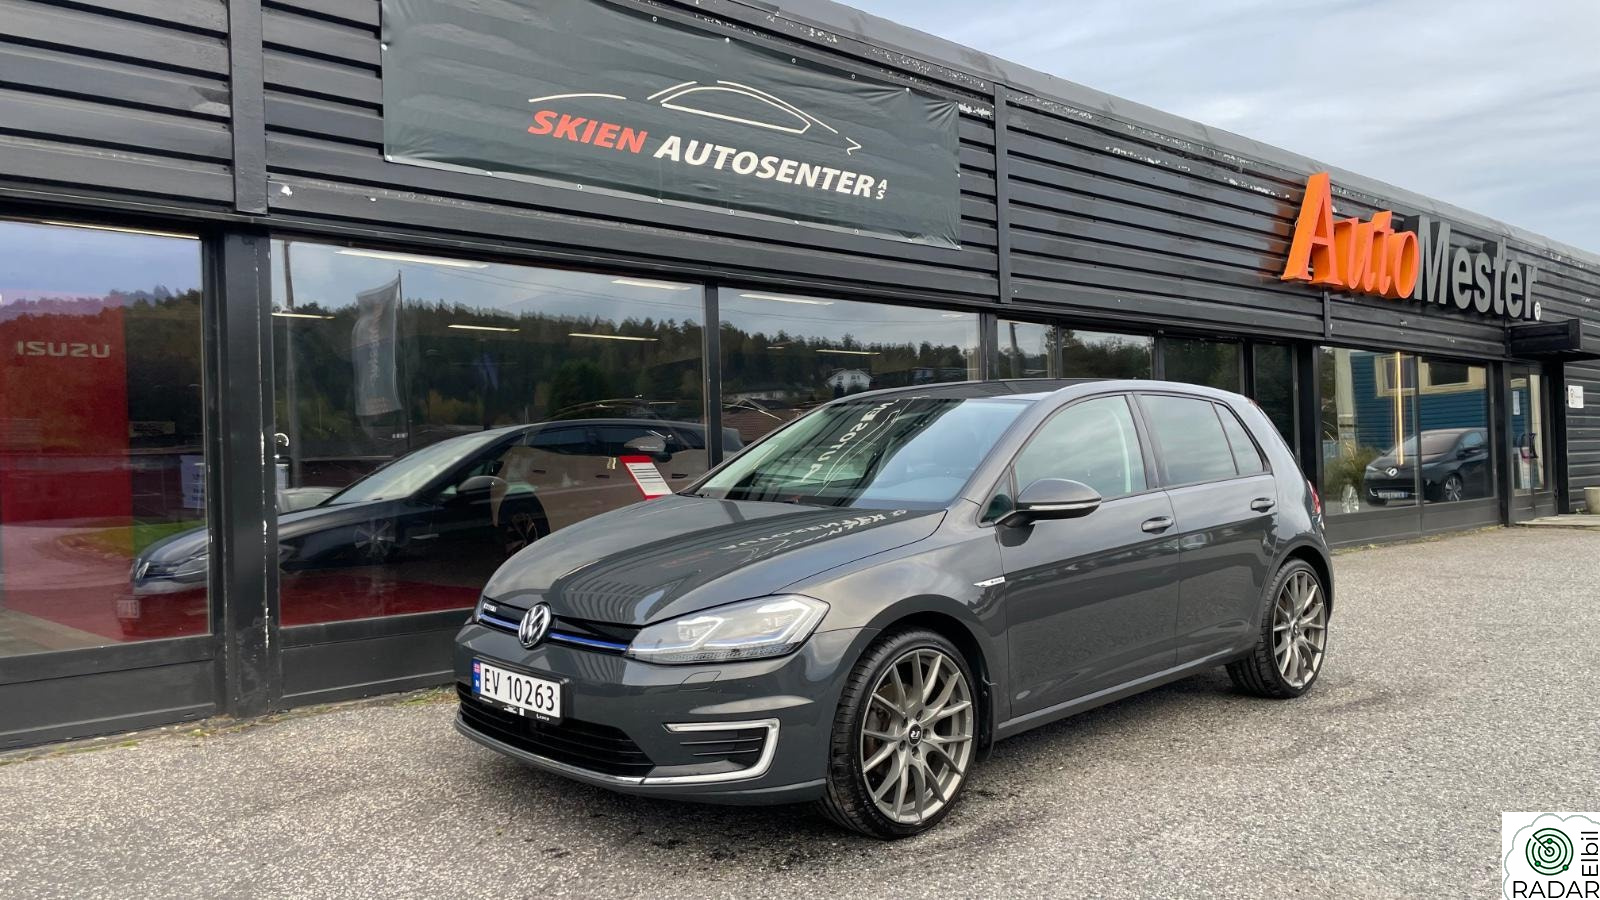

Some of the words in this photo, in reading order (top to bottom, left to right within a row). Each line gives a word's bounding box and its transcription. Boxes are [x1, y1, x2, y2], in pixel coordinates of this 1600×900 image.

[528, 110, 648, 153] SKIEN
[653, 135, 875, 198] AUTOSENTER
[17, 340, 110, 358] ISUZU
[484, 668, 500, 695] EV
[507, 675, 555, 712] 10263
